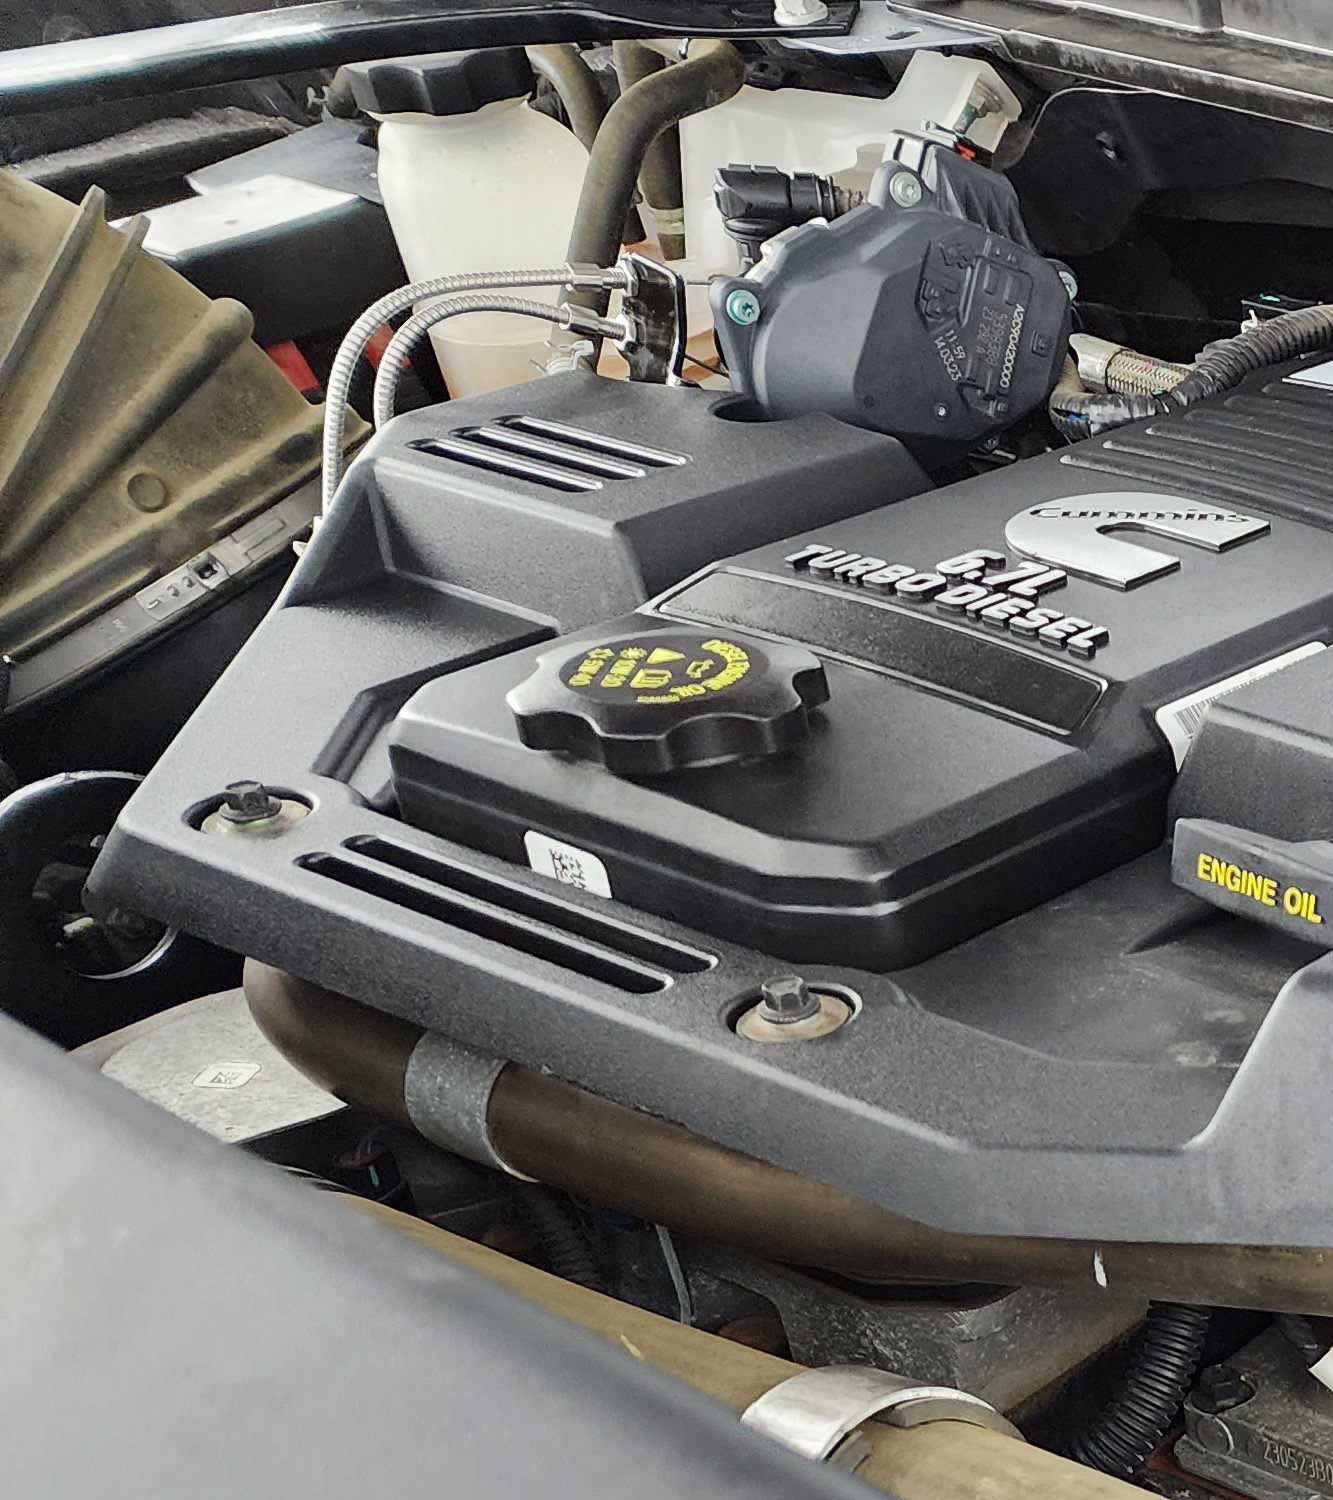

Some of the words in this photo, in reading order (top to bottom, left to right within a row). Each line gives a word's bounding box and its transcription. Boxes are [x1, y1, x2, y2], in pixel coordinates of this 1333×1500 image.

[1028, 505, 1250, 524] Cummins
[784, 543, 948, 597] TURBO
[934, 583, 1110, 656] DIESEL
[1197, 853, 1278, 907] ENGINE
[1284, 886, 1323, 924] OIL
